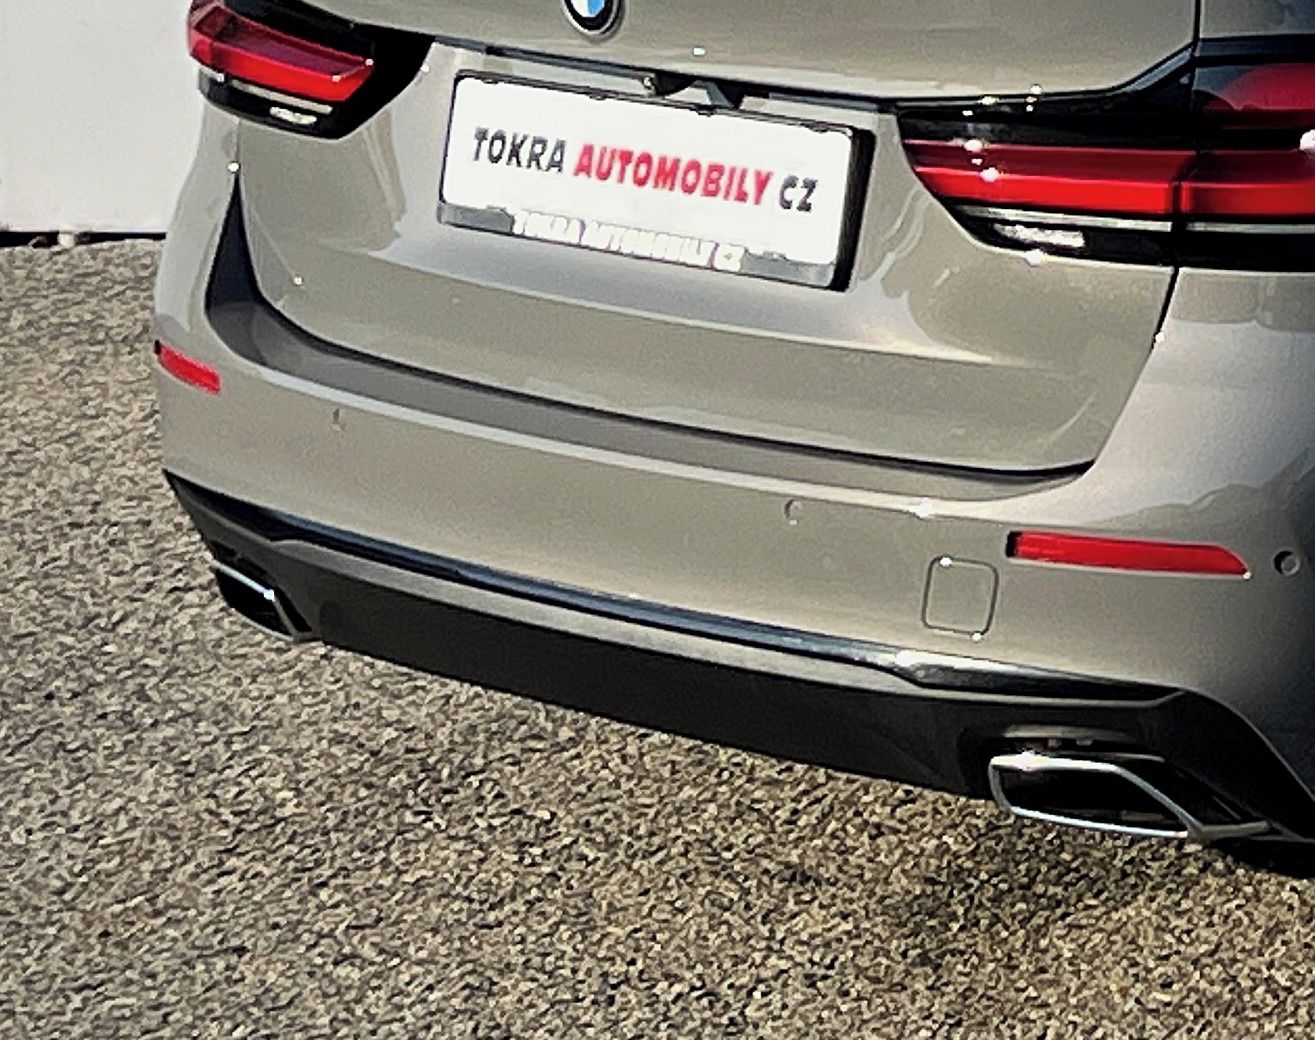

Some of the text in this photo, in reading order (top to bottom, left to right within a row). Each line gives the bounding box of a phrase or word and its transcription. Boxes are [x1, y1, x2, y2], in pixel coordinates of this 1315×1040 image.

[473, 126, 819, 213] TOKRA AUTOMOBILY CZ
